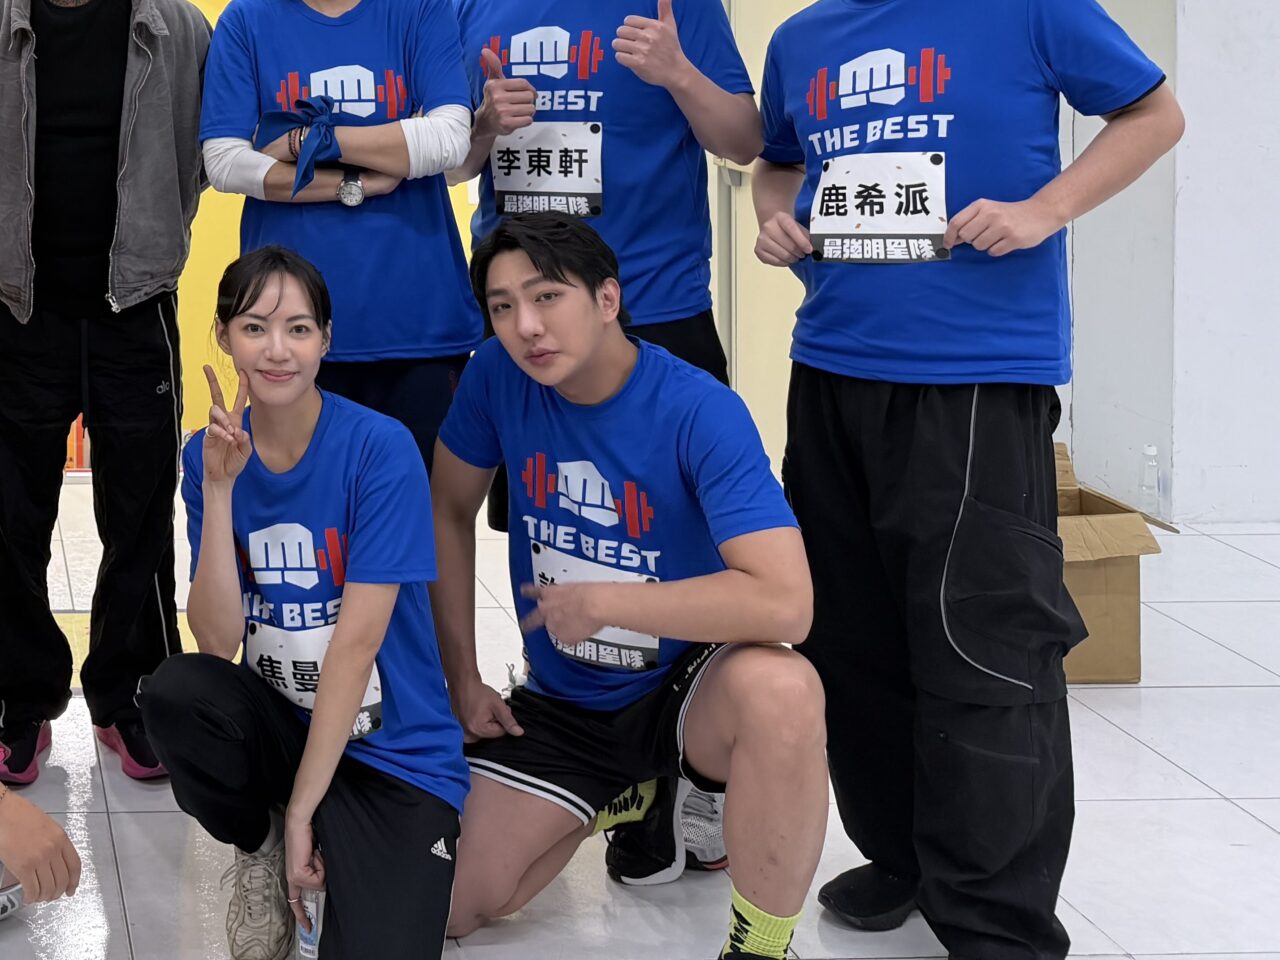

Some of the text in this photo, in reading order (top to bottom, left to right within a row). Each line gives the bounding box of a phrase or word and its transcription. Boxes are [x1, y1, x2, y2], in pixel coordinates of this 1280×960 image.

[535, 90, 604, 112] BEST
[808, 114, 955, 155] THE BEST
[497, 147, 588, 178] 李東軒
[819, 182, 931, 217] 鹿希派
[823, 239, 936, 260] 最強明星隊
[522, 515, 661, 573] THE BEST
[282, 597, 342, 628] BES
